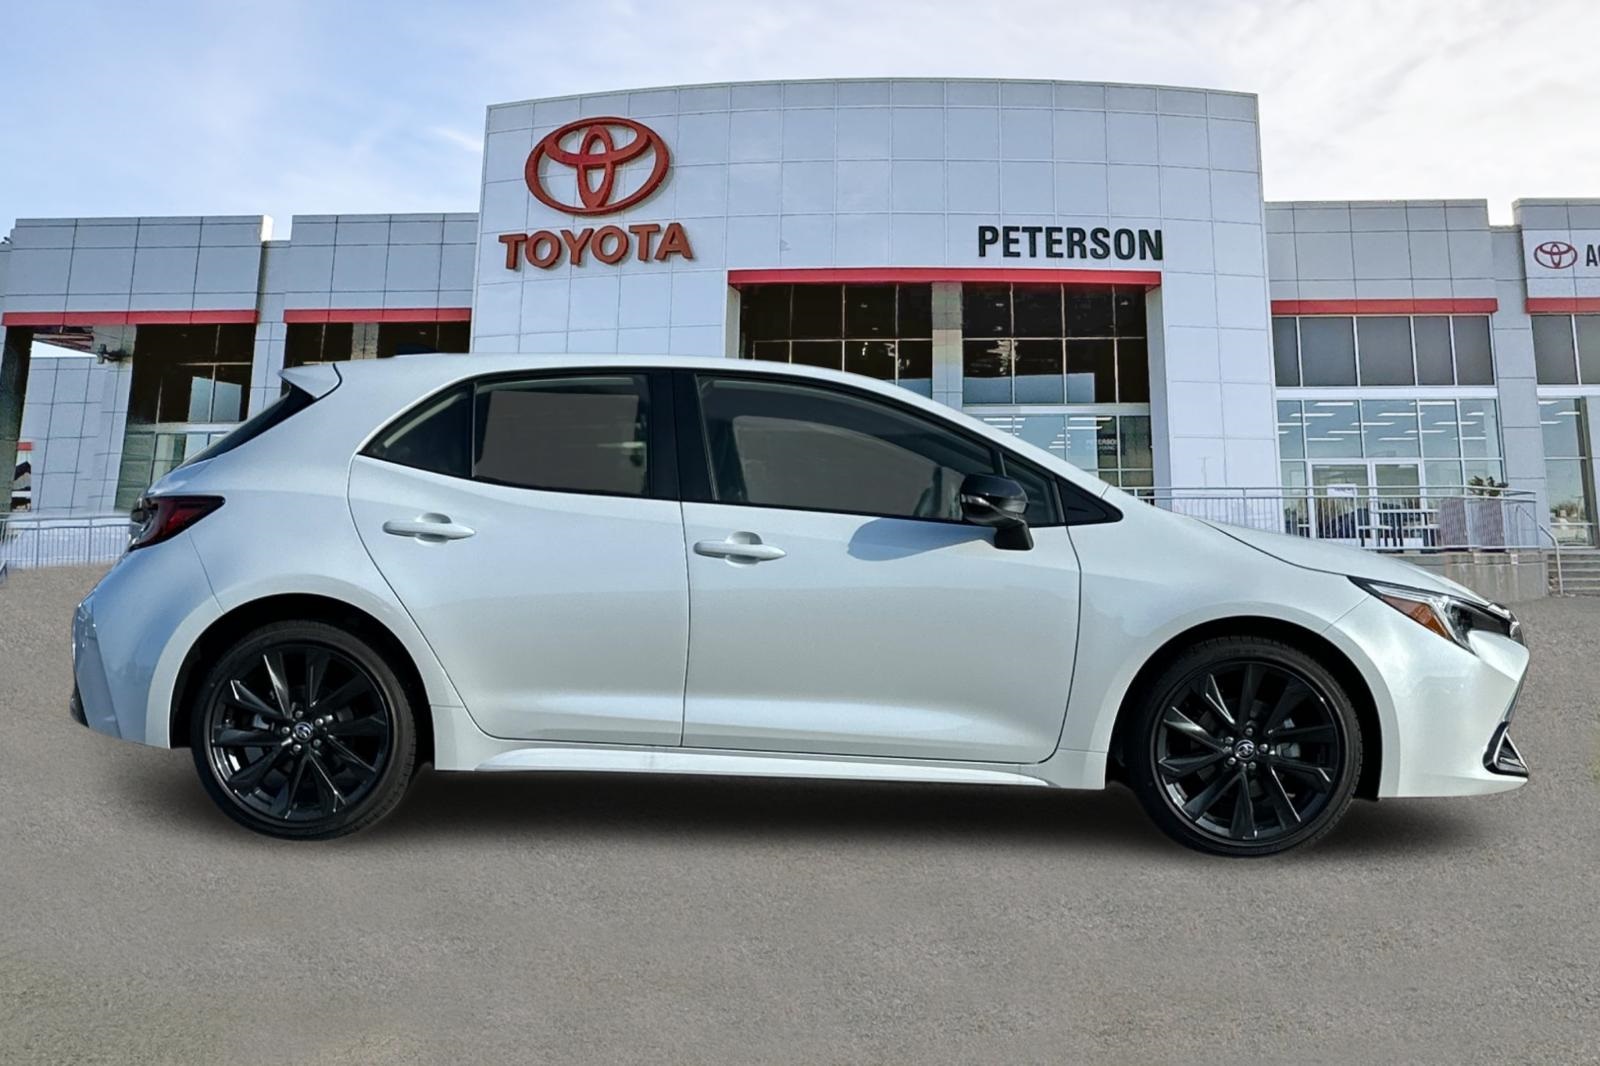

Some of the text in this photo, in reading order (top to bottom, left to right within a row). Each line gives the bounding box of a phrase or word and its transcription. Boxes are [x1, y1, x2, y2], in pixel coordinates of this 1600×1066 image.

[498, 222, 693, 270] TOYOTA
[978, 225, 1164, 261] PETERSON
[1586, 244, 1600, 267] A
